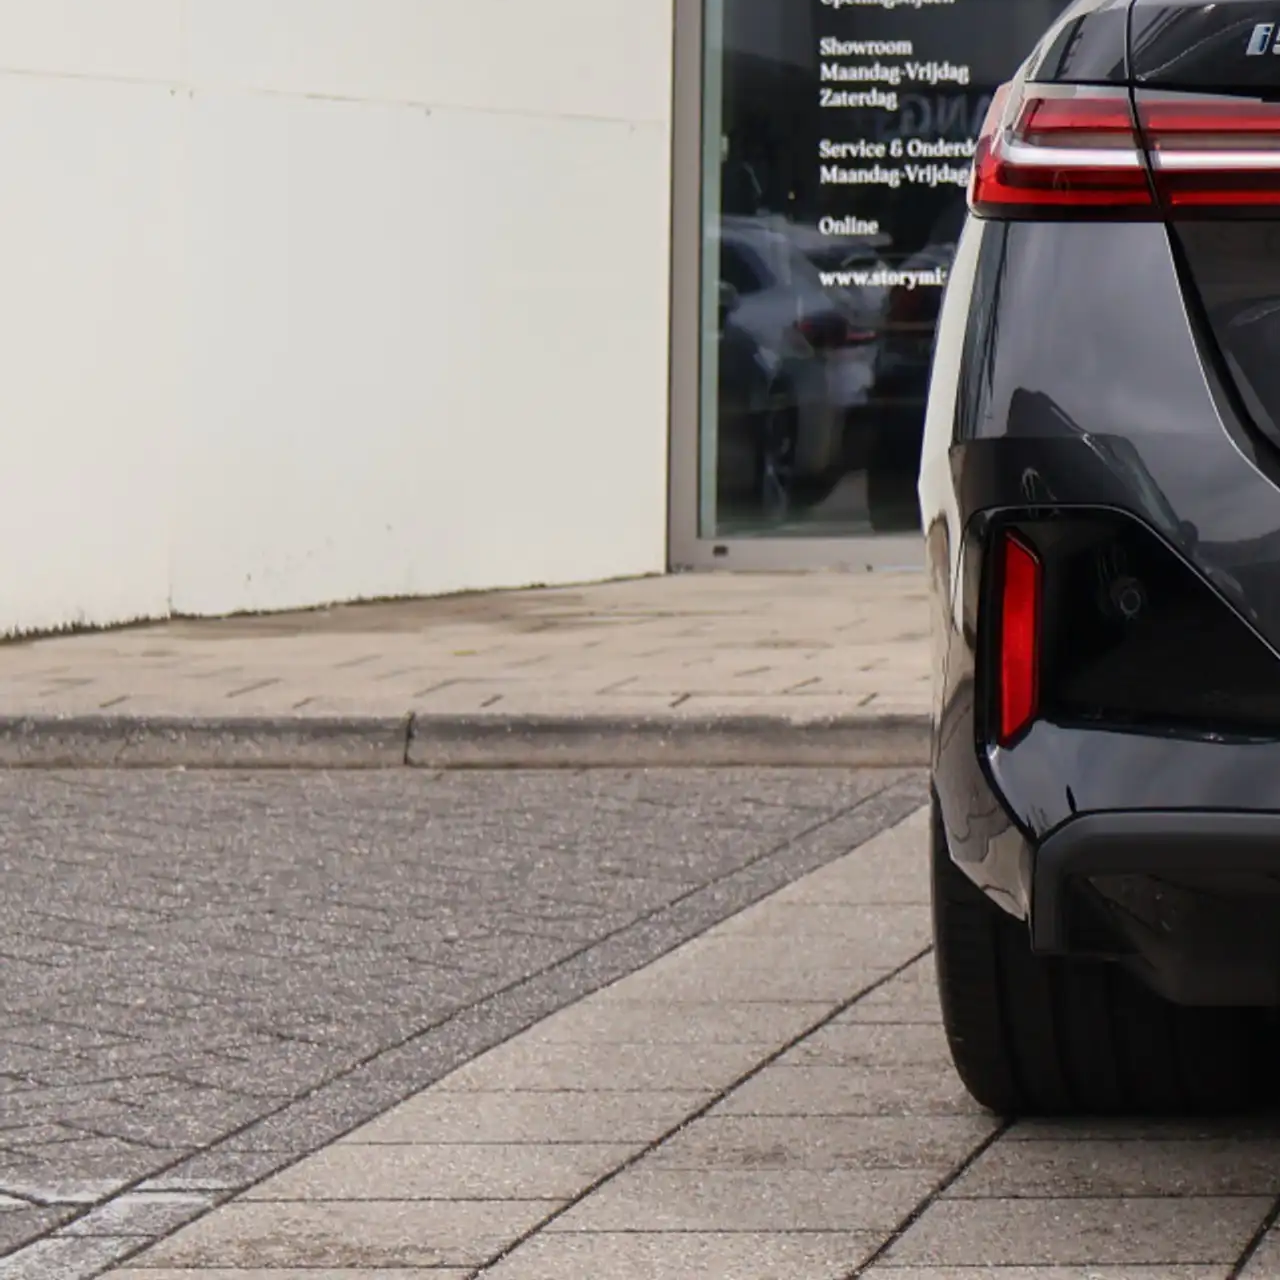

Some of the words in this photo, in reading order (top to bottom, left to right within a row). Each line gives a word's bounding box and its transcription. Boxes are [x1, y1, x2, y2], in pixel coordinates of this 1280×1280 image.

[820, 35, 912, 56] Showroom
[820, 62, 969, 84] Maandag-Vrijdag
[820, 88, 897, 111] Zaterdag
[819, 139, 885, 157] Service
[890, 138, 903, 157] &
[820, 164, 969, 187] Maandag-Vrijdag
[819, 216, 878, 235] Online
[819, 267, 947, 289] www.storymi
